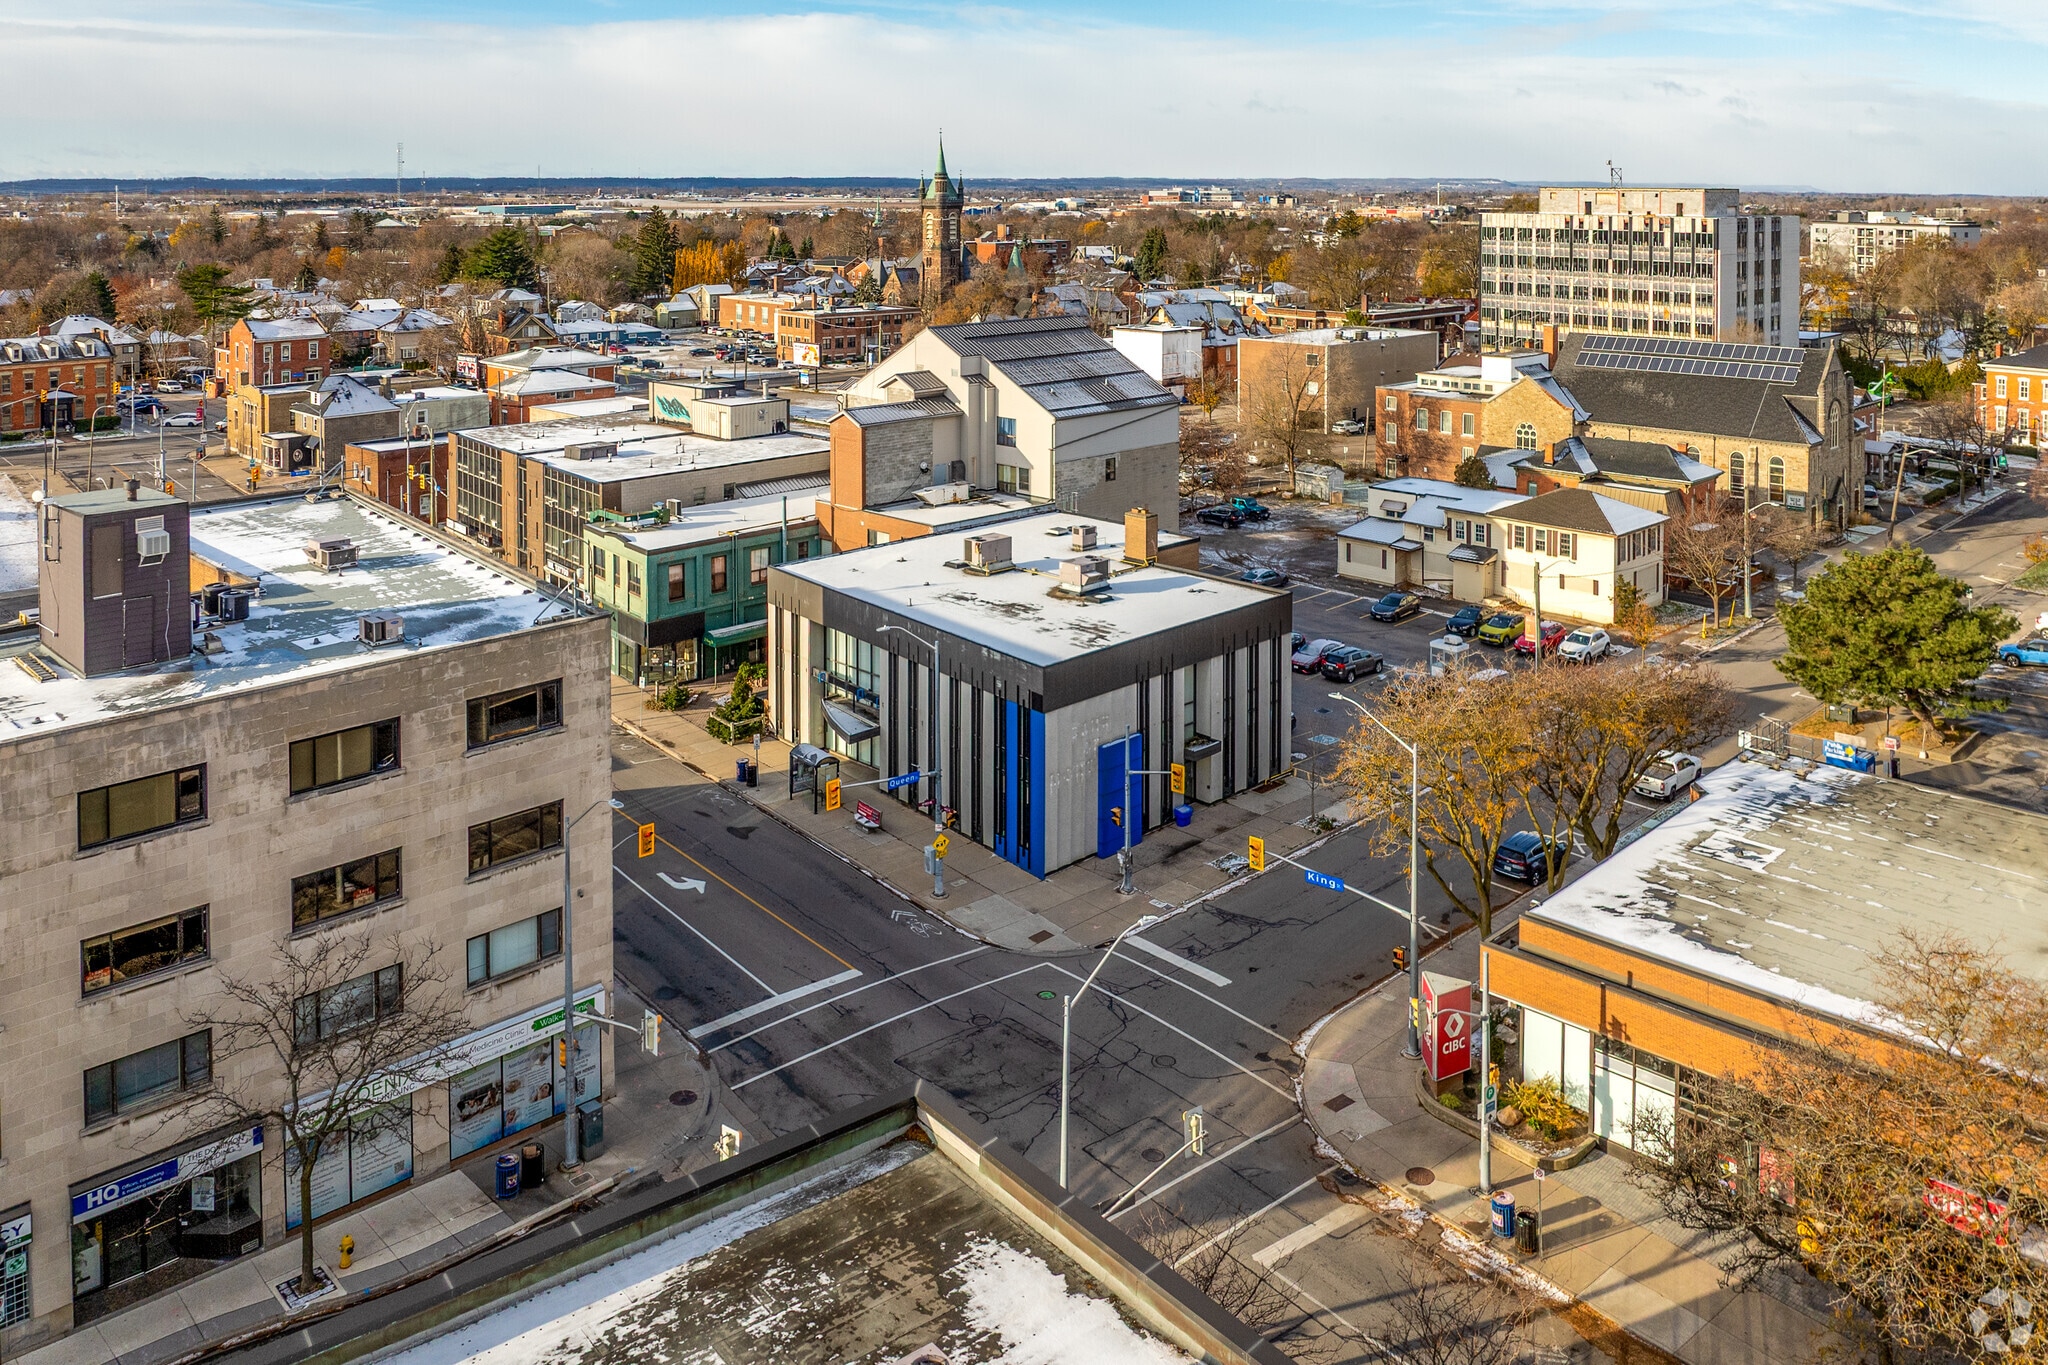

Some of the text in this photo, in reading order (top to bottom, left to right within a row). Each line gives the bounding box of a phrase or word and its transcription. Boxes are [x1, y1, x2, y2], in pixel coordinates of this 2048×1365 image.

[889, 775, 915, 787] Queen
[1307, 872, 1336, 889] King
[470, 1035, 504, 1054] Medicine
[504, 1027, 525, 1041] Clinic
[1442, 1036, 1466, 1055] CIBC
[330, 1070, 416, 1111] POENIX
[187, 1134, 246, 1162] THE DOON
[86, 1184, 120, 1209] HQ
